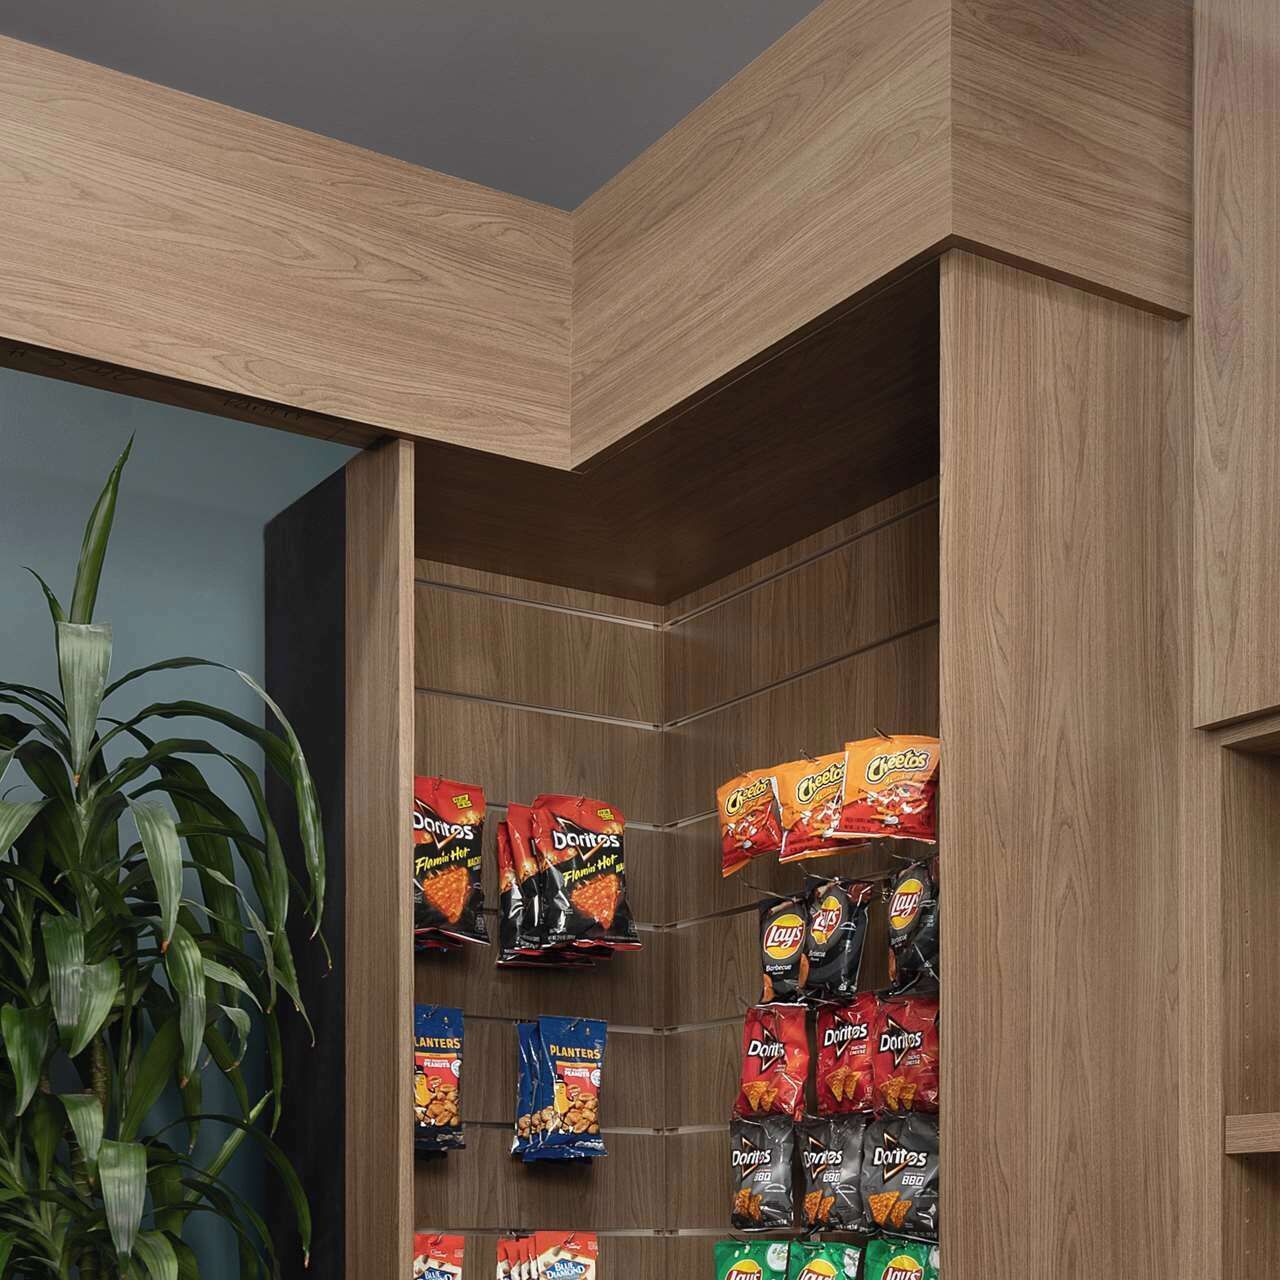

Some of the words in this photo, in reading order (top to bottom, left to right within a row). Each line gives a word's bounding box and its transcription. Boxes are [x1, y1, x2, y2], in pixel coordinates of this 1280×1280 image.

[866, 749, 930, 782] Cheetos
[797, 763, 845, 802] Cheeto
[726, 777, 770, 815] Cheetos
[413, 812, 474, 840] Doritos
[553, 830, 620, 851] Doritos
[451, 846, 471, 860] Hot
[597, 853, 619, 870] Hot
[824, 1023, 867, 1046] Doritos
[880, 1032, 922, 1052] Doritos
[550, 1044, 601, 1059] PLANTERS
[732, 1149, 771, 1168] Doritos
[873, 1147, 927, 1167] Doritos
[901, 1174, 925, 1186] BBQ
[546, 1266, 586, 1279] DIAMOND
[554, 1261, 575, 1271] BLUE
